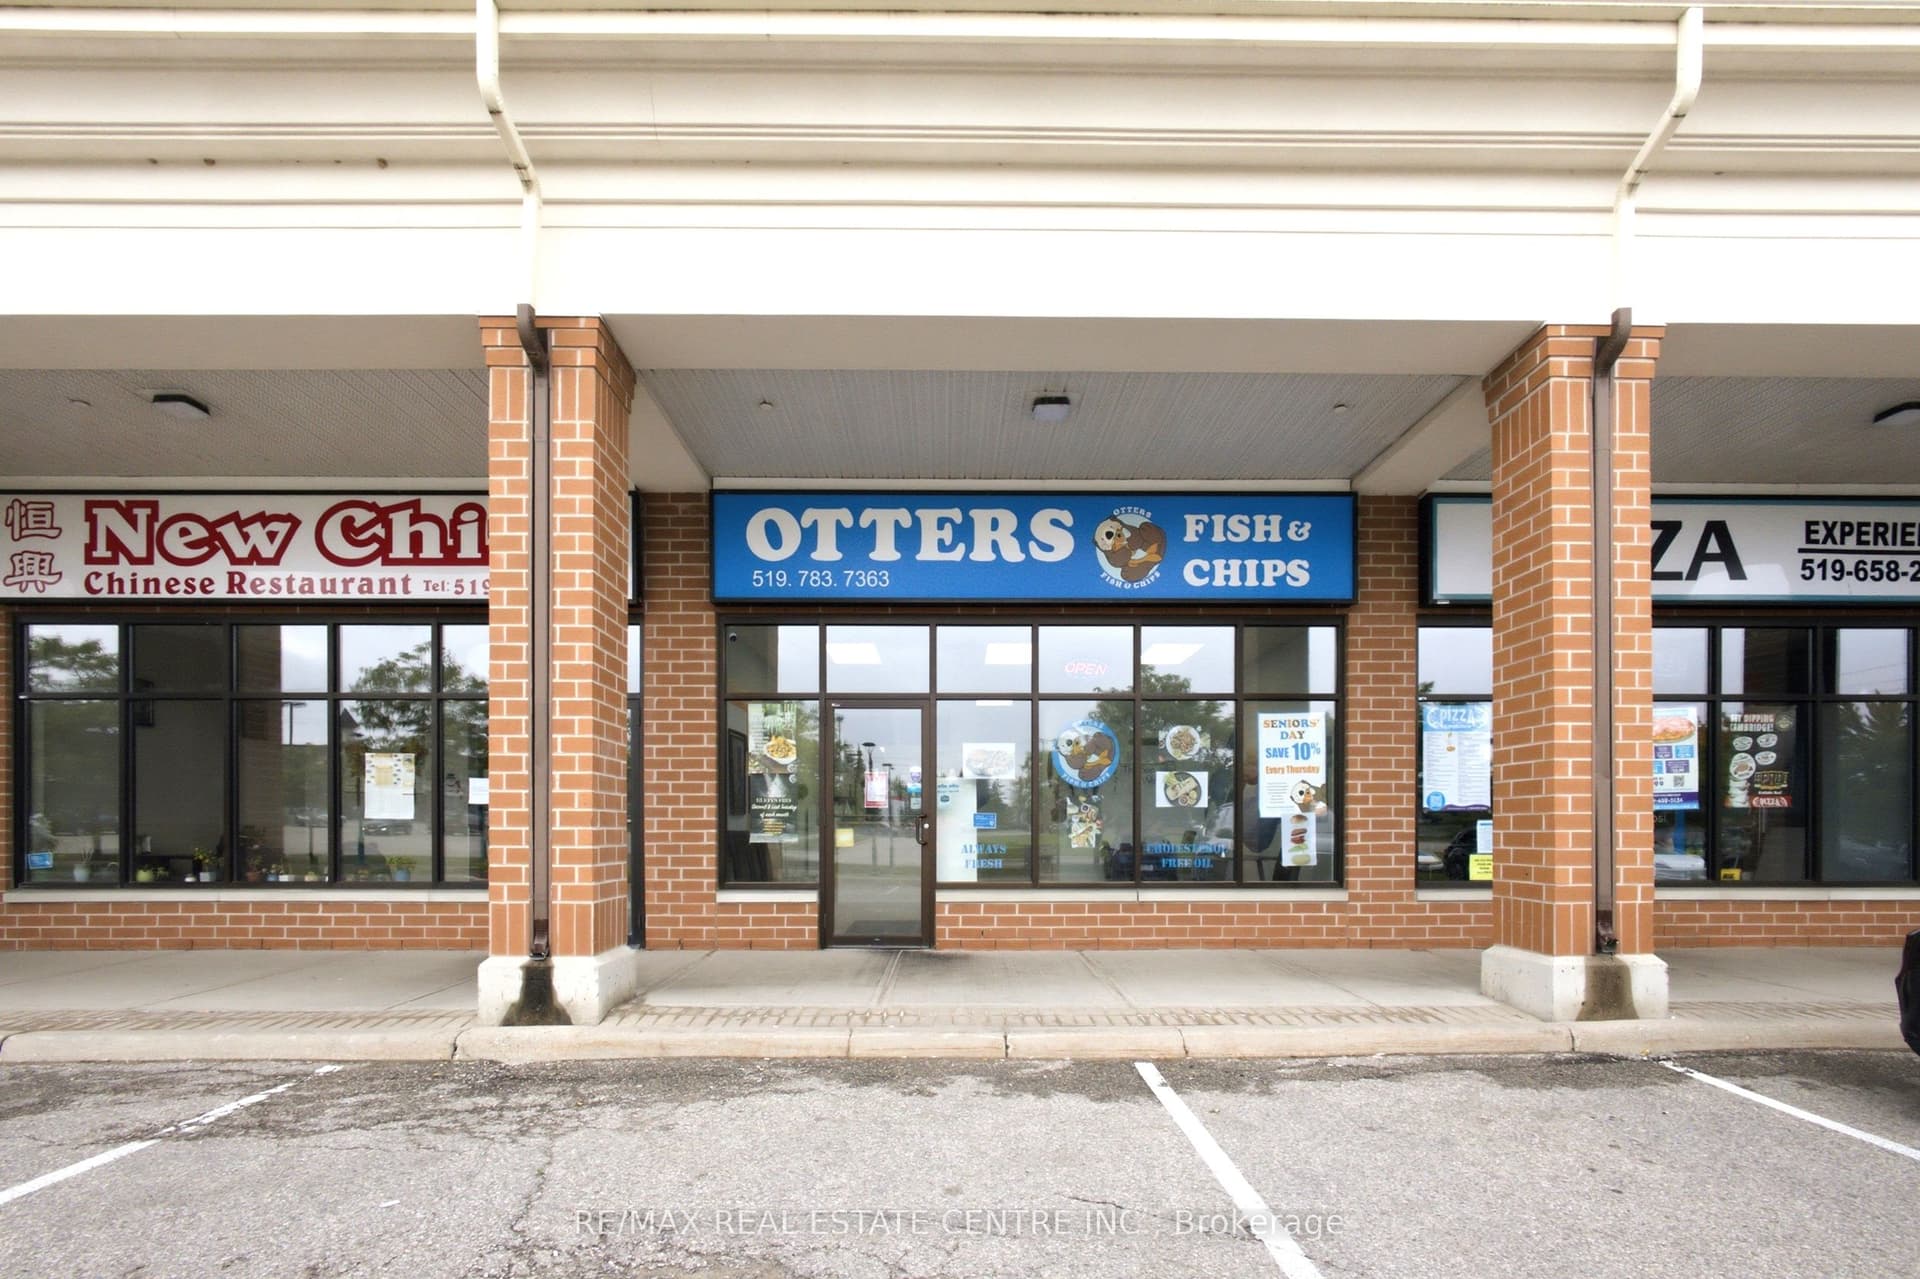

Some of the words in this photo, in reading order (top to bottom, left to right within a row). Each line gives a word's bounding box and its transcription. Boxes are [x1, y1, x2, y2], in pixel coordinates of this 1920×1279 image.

[84, 499, 302, 567] New
[315, 497, 489, 567] Chi
[746, 507, 1075, 563] OTTERS
[1183, 514, 1283, 543] FISH
[1286, 520, 1312, 542] &
[1804, 520, 1920, 548] EXPERIE
[84, 571, 215, 595] Chinese
[226, 571, 411, 595] Restaurant
[423, 579, 450, 592] Tel:
[752, 570, 792, 588] 519.
[798, 570, 837, 588] 783.
[844, 570, 889, 588] 7363
[1183, 558, 1310, 587] CHIPS
[1064, 662, 1109, 676] OPEN
[1280, 730, 1305, 740] DAY
[1265, 747, 1289, 759] SAVE
[1292, 742, 1321, 761] 10%
[1265, 766, 1285, 775] Every
[1286, 764, 1320, 775] Thursday
[961, 844, 1007, 855] ALWAYS
